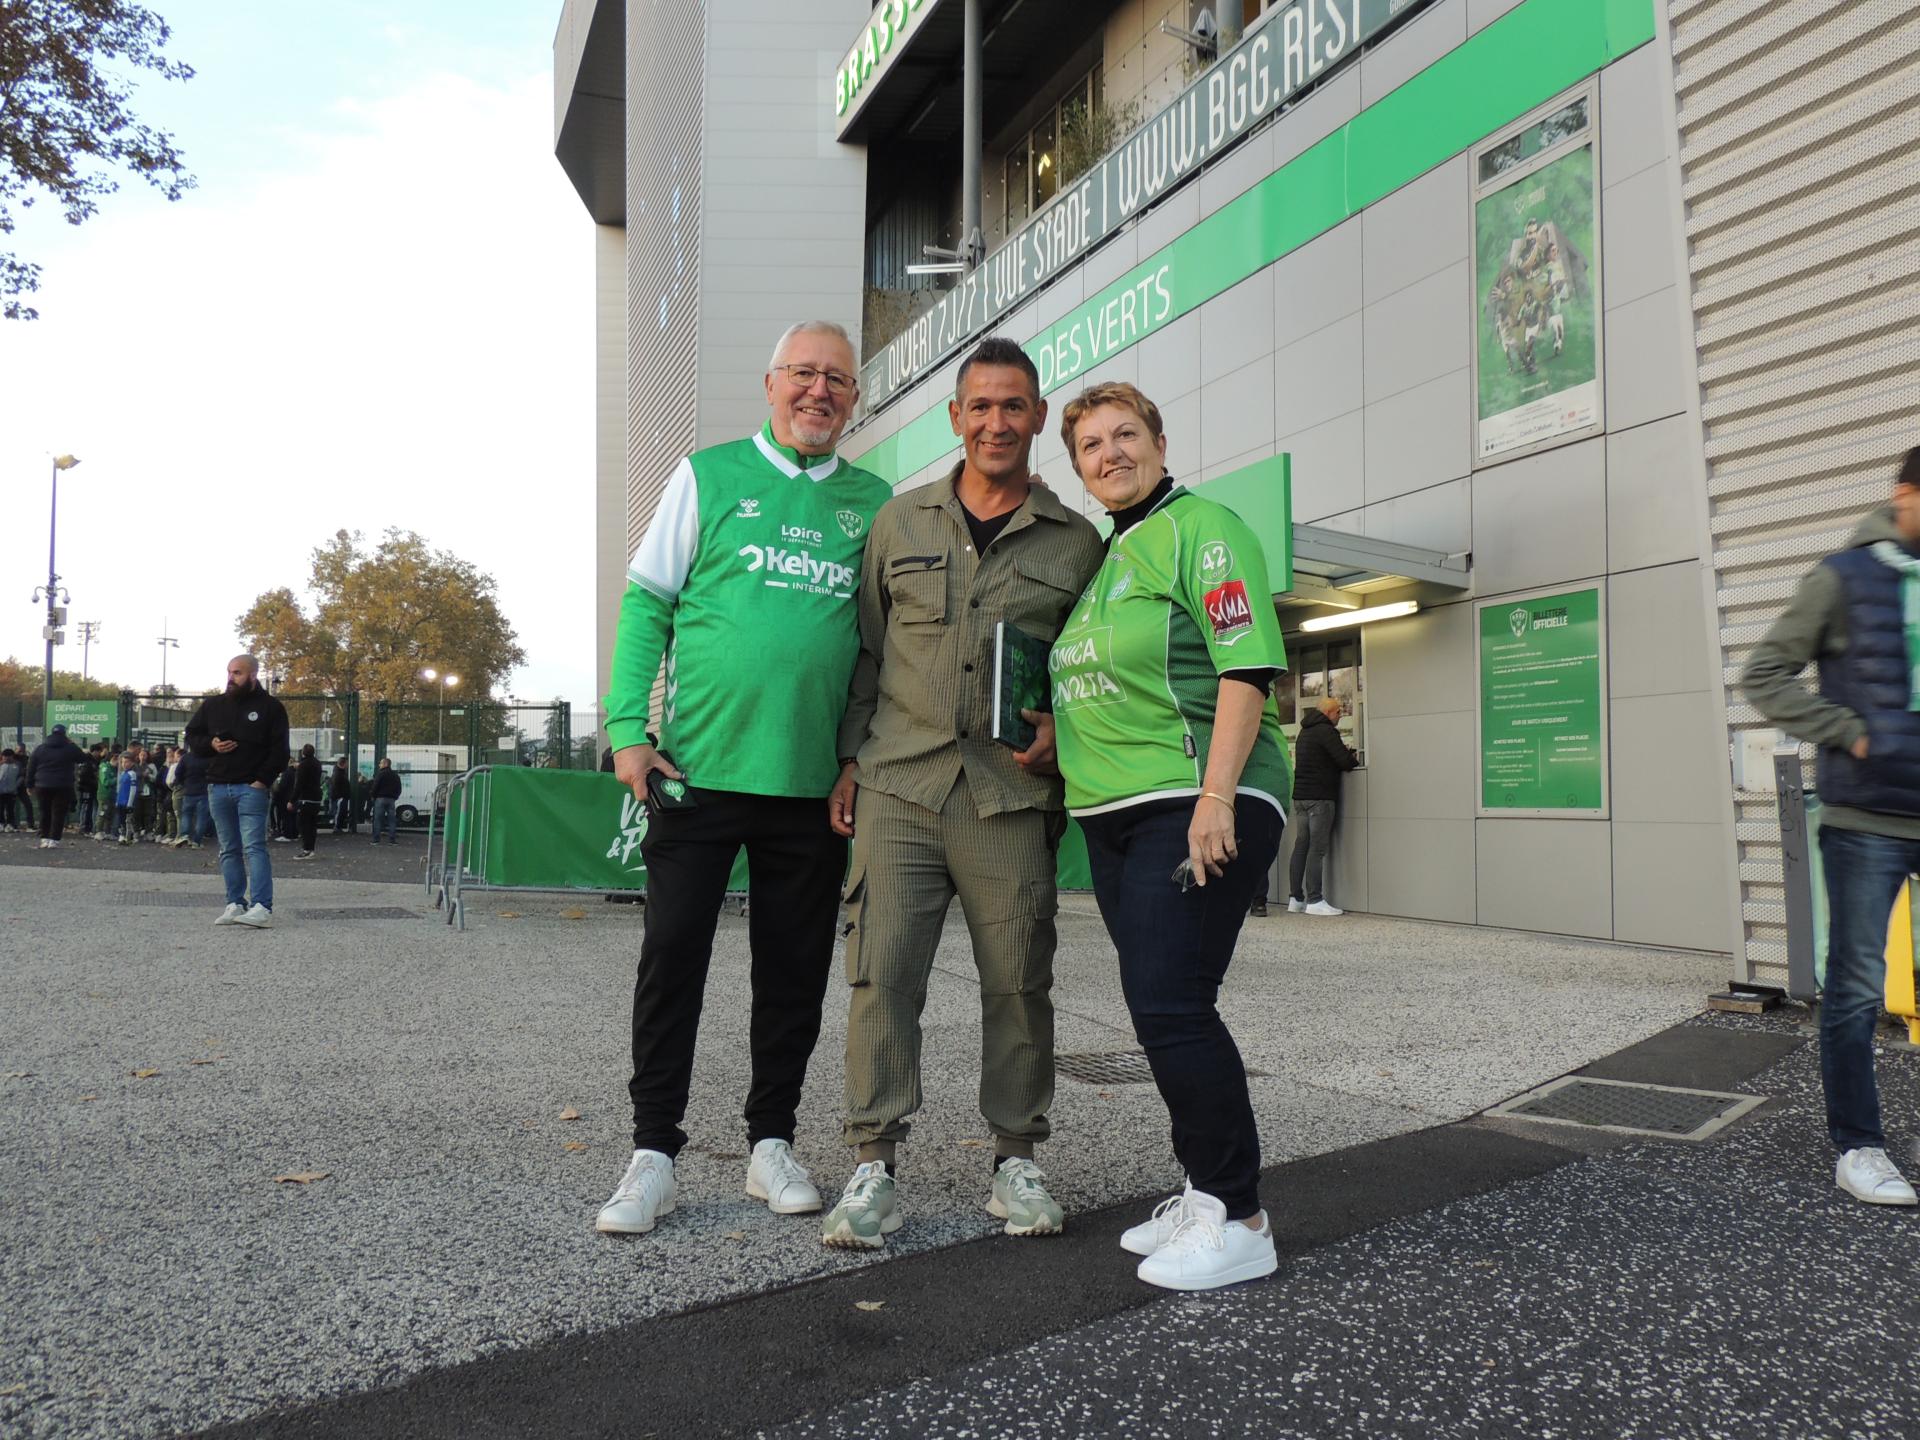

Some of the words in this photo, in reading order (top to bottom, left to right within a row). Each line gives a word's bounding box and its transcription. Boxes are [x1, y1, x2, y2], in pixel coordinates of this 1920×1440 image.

[836, 0, 923, 117] BRASS
[888, 310, 934, 391] OUVERT
[994, 232, 1027, 309] VUE
[1033, 179, 1091, 281] STADE
[1040, 323, 1082, 391] DES
[1086, 264, 1171, 359] VERTS
[781, 524, 823, 542] Loire
[765, 546, 855, 588] Kelyps
[1202, 546, 1226, 570] 42
[792, 582, 832, 595] INTERIM
[1533, 607, 1568, 619] BILLETTERIE
[1533, 615, 1568, 630] OFFICIELLE
[1050, 637, 1098, 672] ONICA
[68, 723, 100, 734] ASSE
